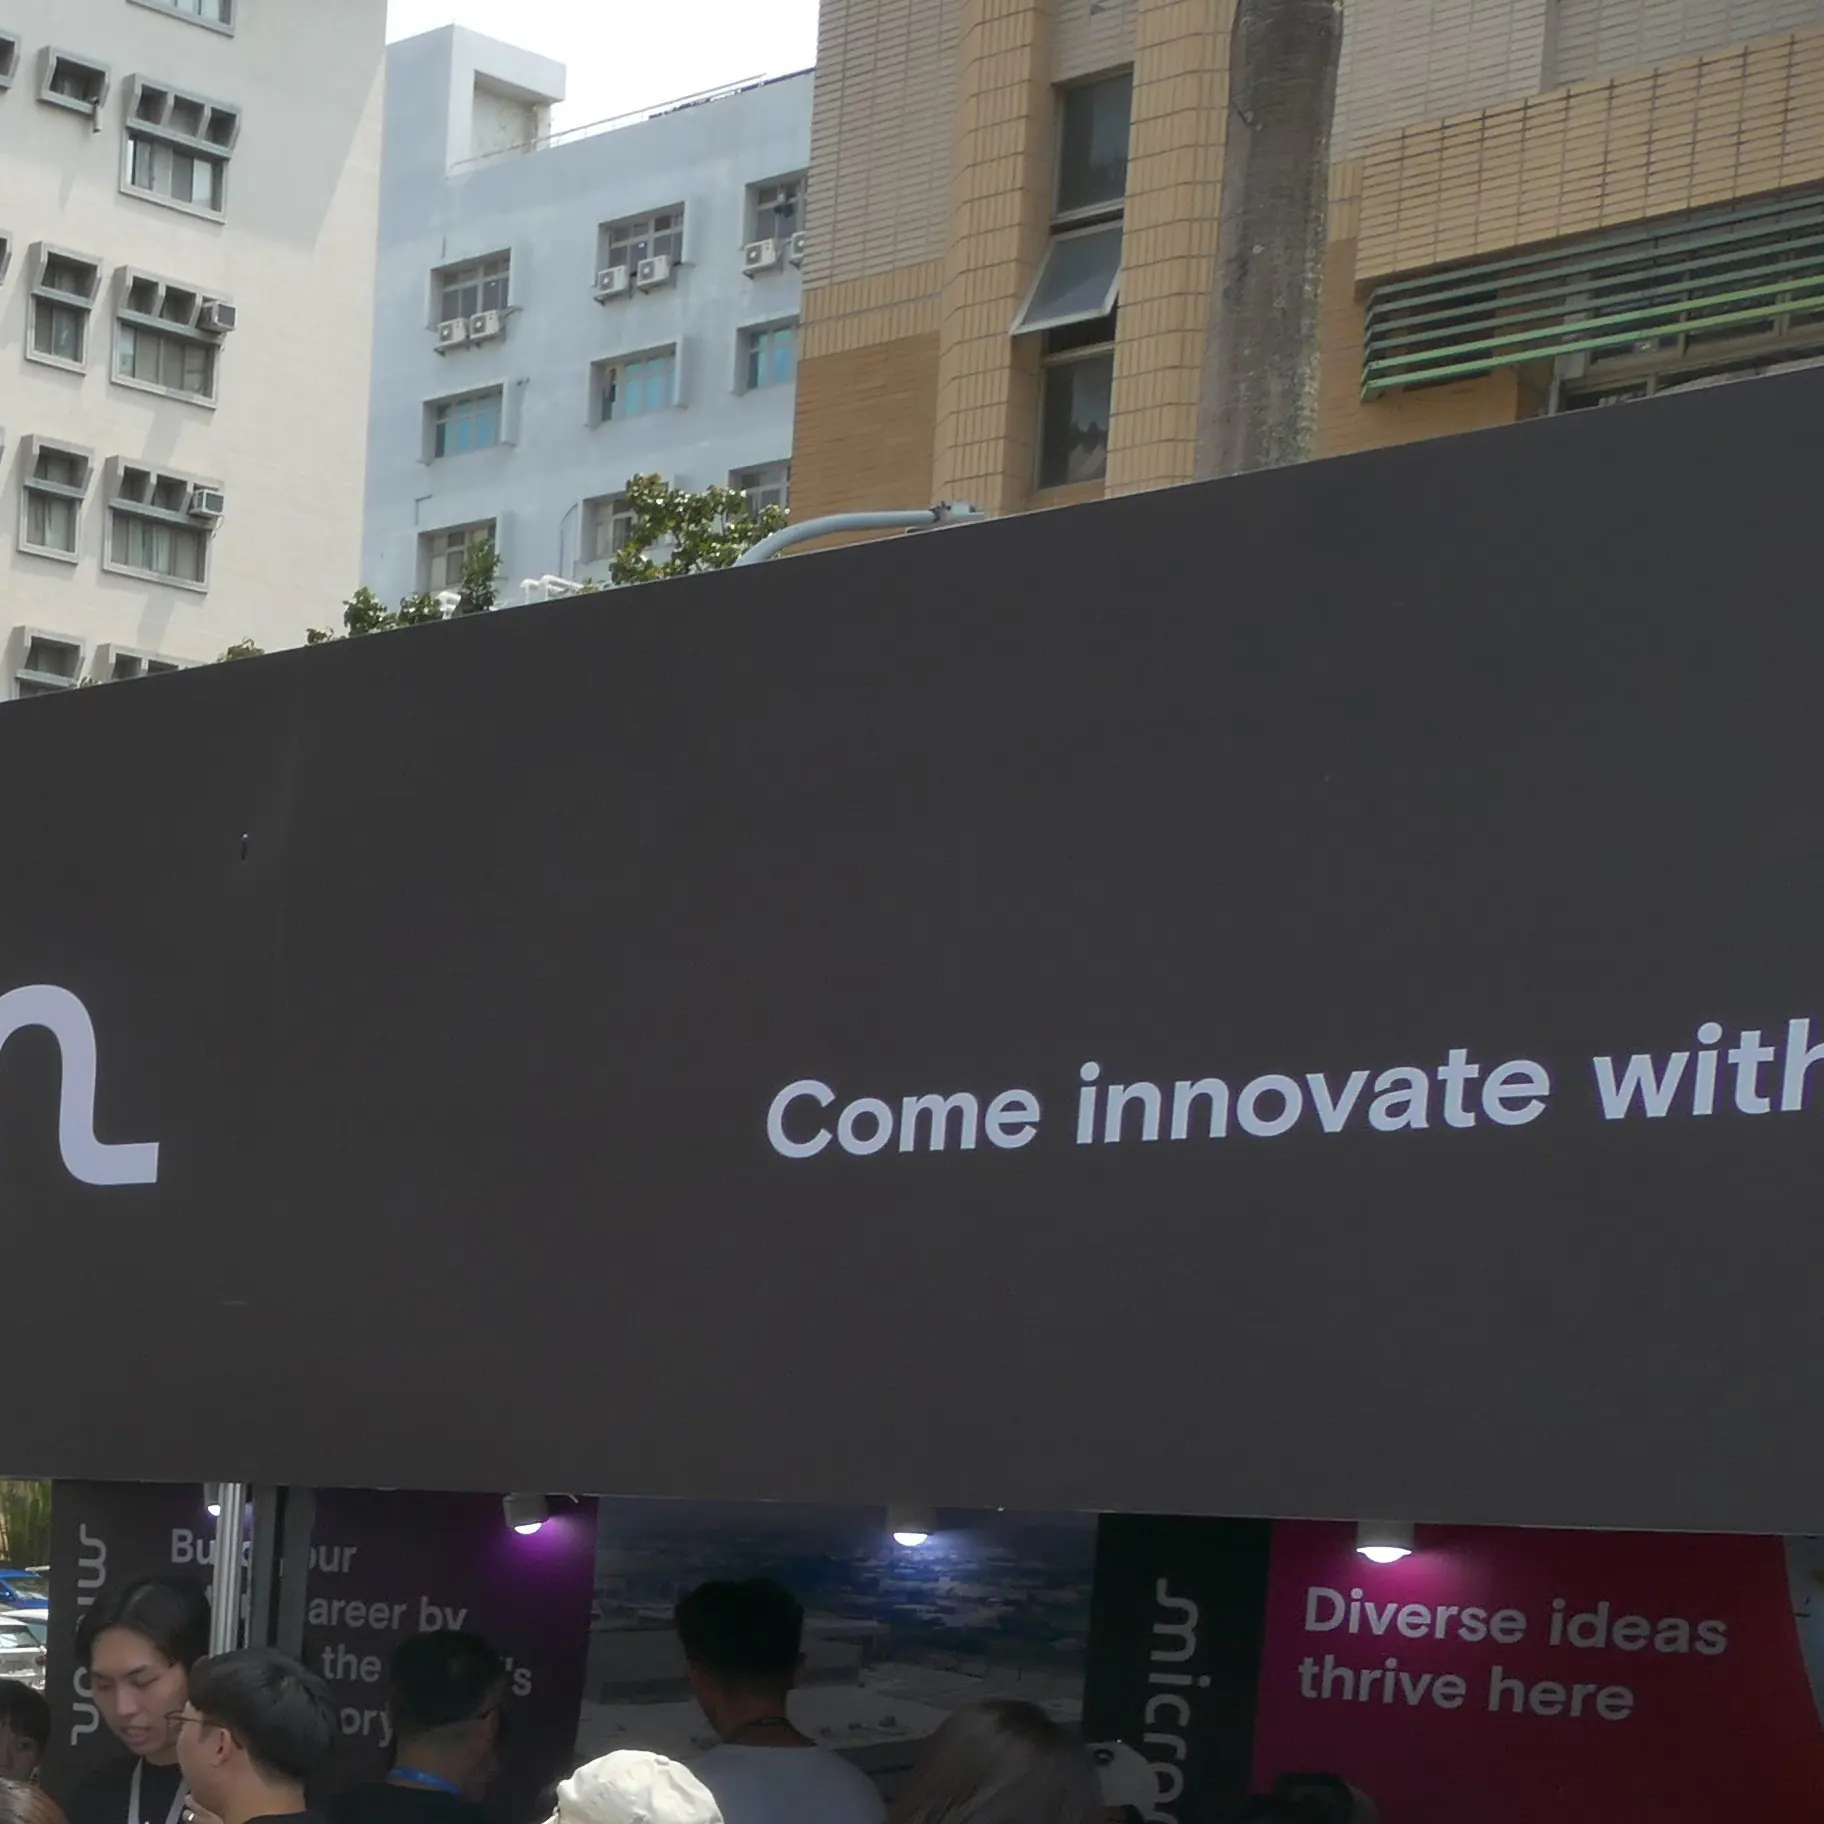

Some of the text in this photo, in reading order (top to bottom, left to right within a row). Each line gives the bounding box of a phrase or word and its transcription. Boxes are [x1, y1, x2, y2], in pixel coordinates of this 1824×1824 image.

[766, 1078, 1041, 1159] Come
[1075, 1048, 1551, 1145] innovate
[308, 1598, 407, 1631] areer
[1305, 1585, 1729, 1657] Diverse ideas
[321, 1643, 382, 1684] the
[1298, 1655, 1636, 1721] thrive here
